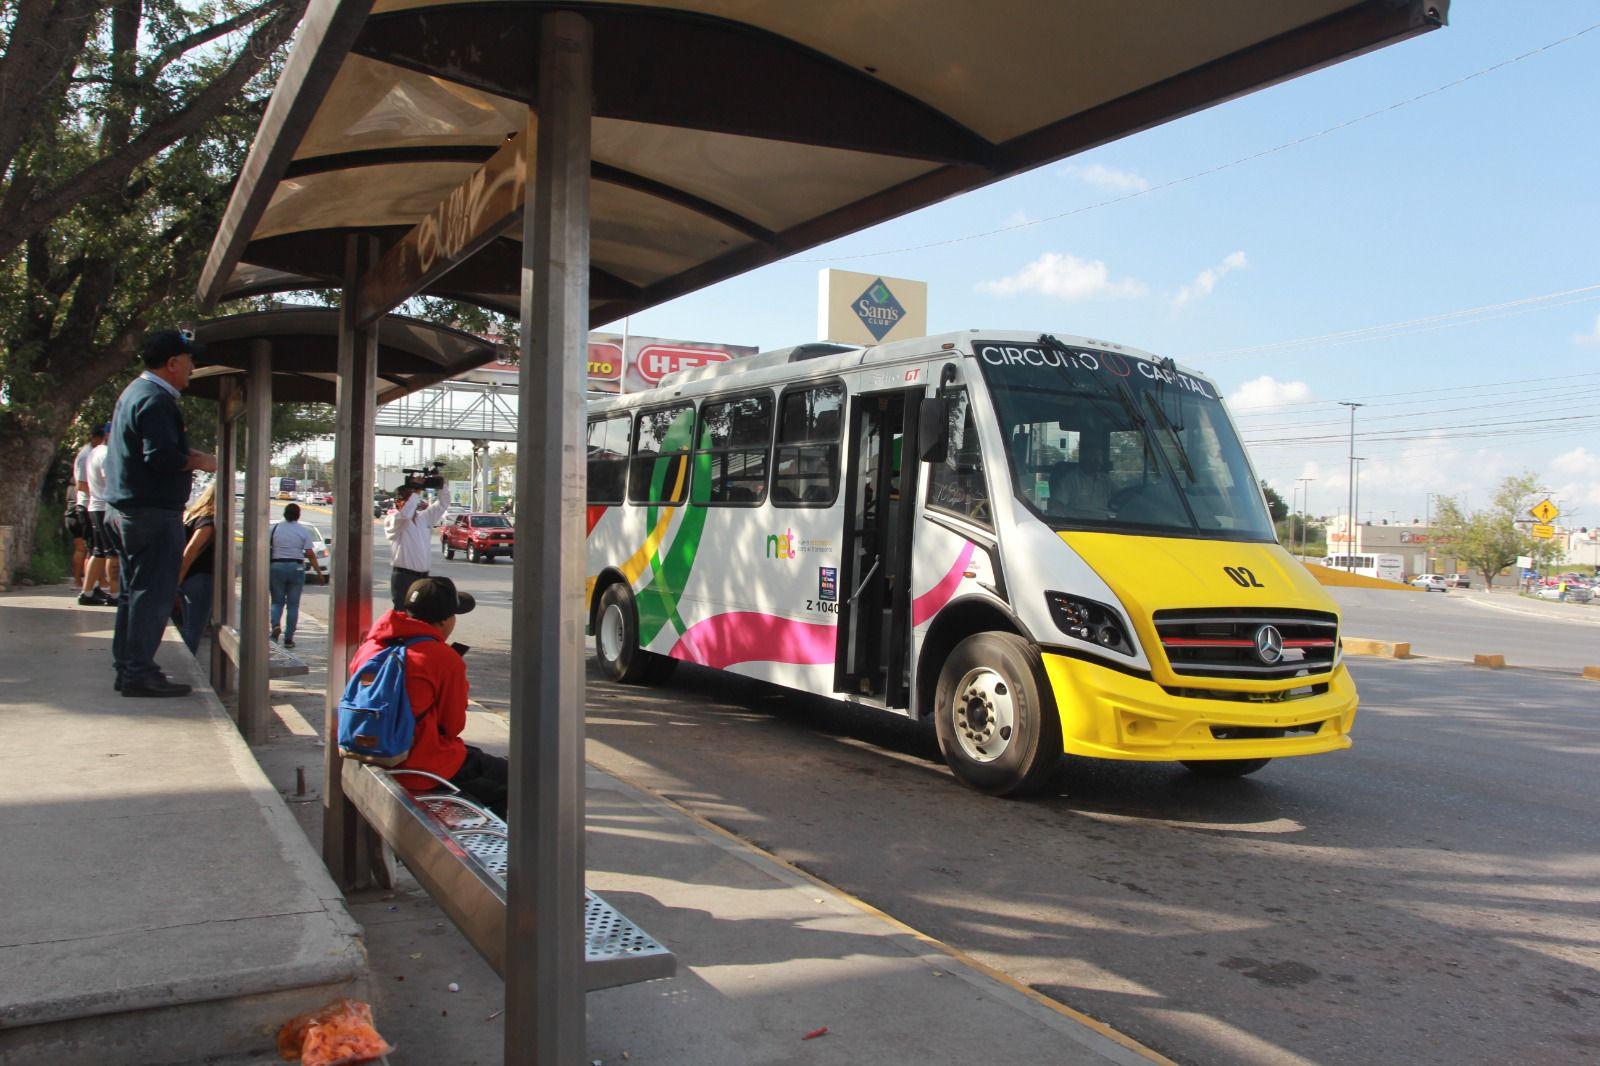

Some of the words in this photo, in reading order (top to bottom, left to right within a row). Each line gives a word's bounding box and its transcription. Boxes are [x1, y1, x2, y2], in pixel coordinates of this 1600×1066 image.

[859, 299, 899, 321] Sam's
[868, 317, 890, 326] CLUB
[904, 367, 921, 382] GT
[766, 527, 796, 560] net
[1223, 566, 1265, 588] 02
[806, 599, 814, 611] Z
